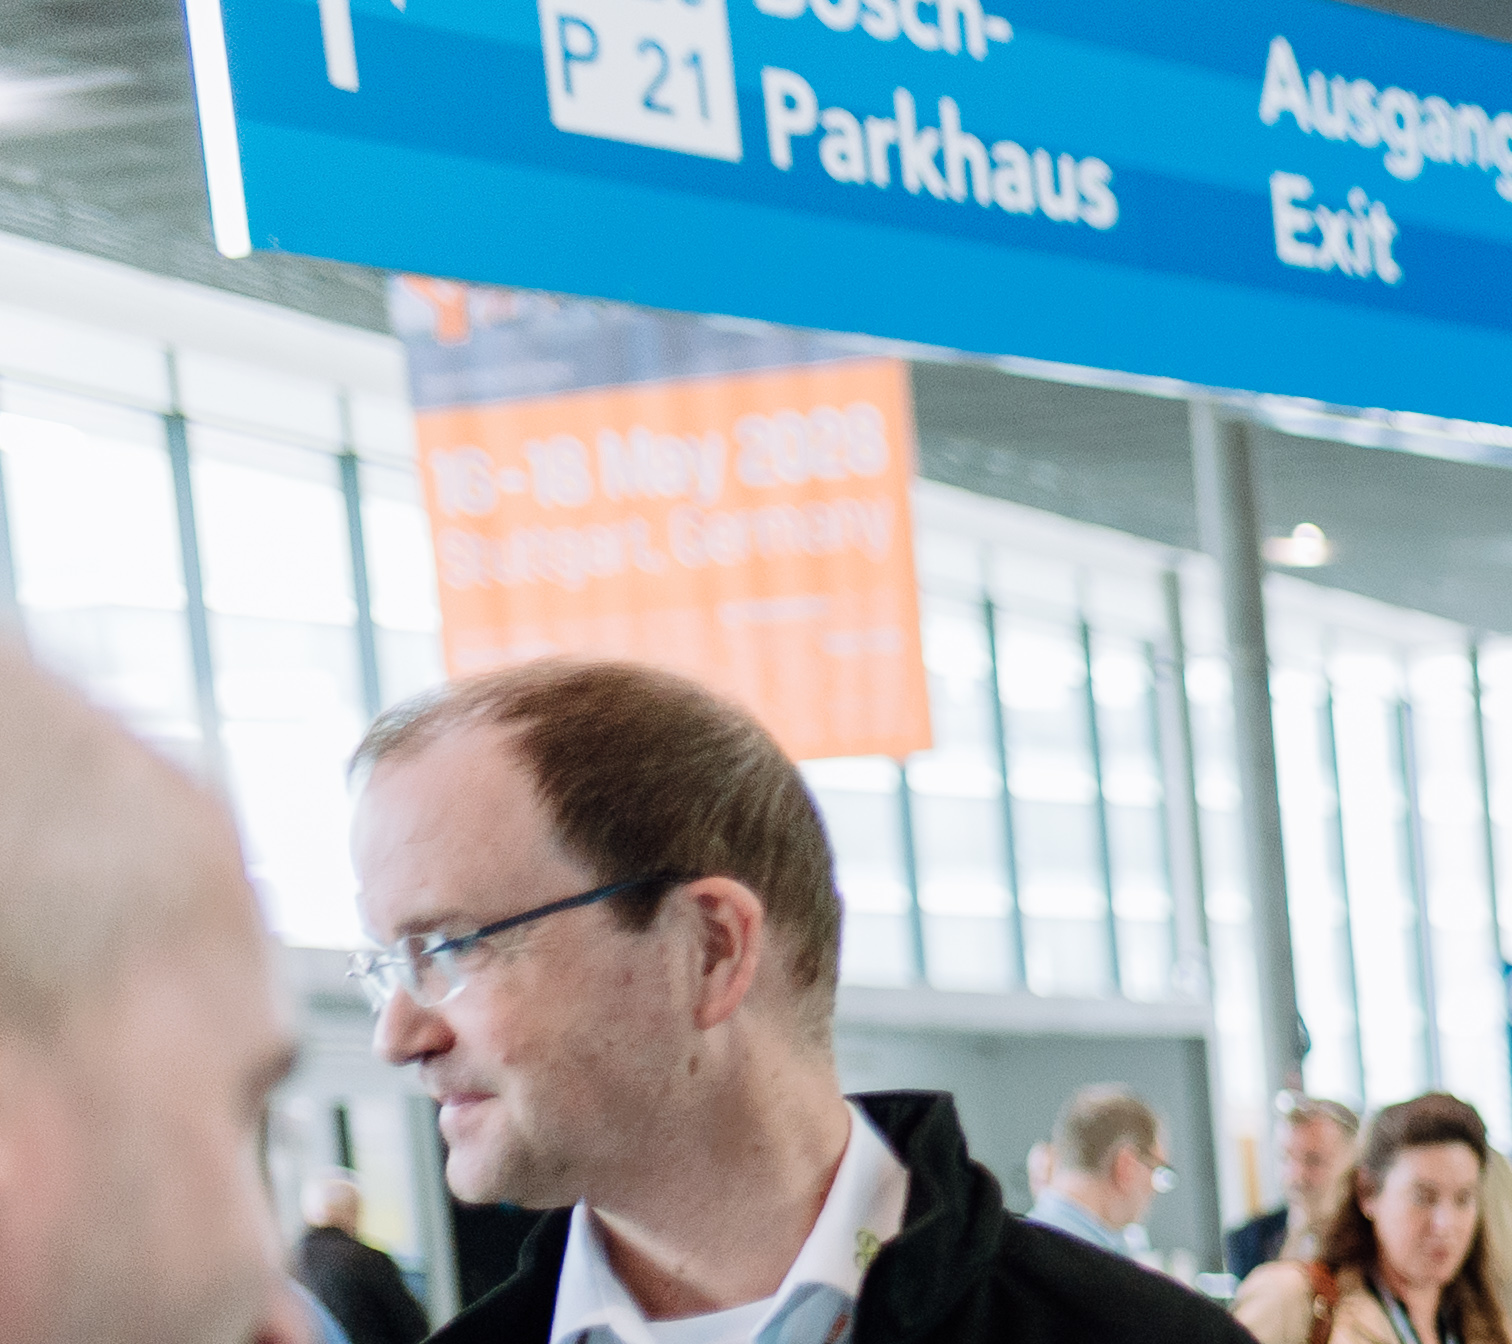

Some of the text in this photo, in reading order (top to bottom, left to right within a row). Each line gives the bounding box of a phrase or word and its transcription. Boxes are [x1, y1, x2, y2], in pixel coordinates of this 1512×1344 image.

[557, 14, 712, 122] P 21
[761, 65, 1119, 231] Parkhaus
[1269, 170, 1403, 285] Exit
